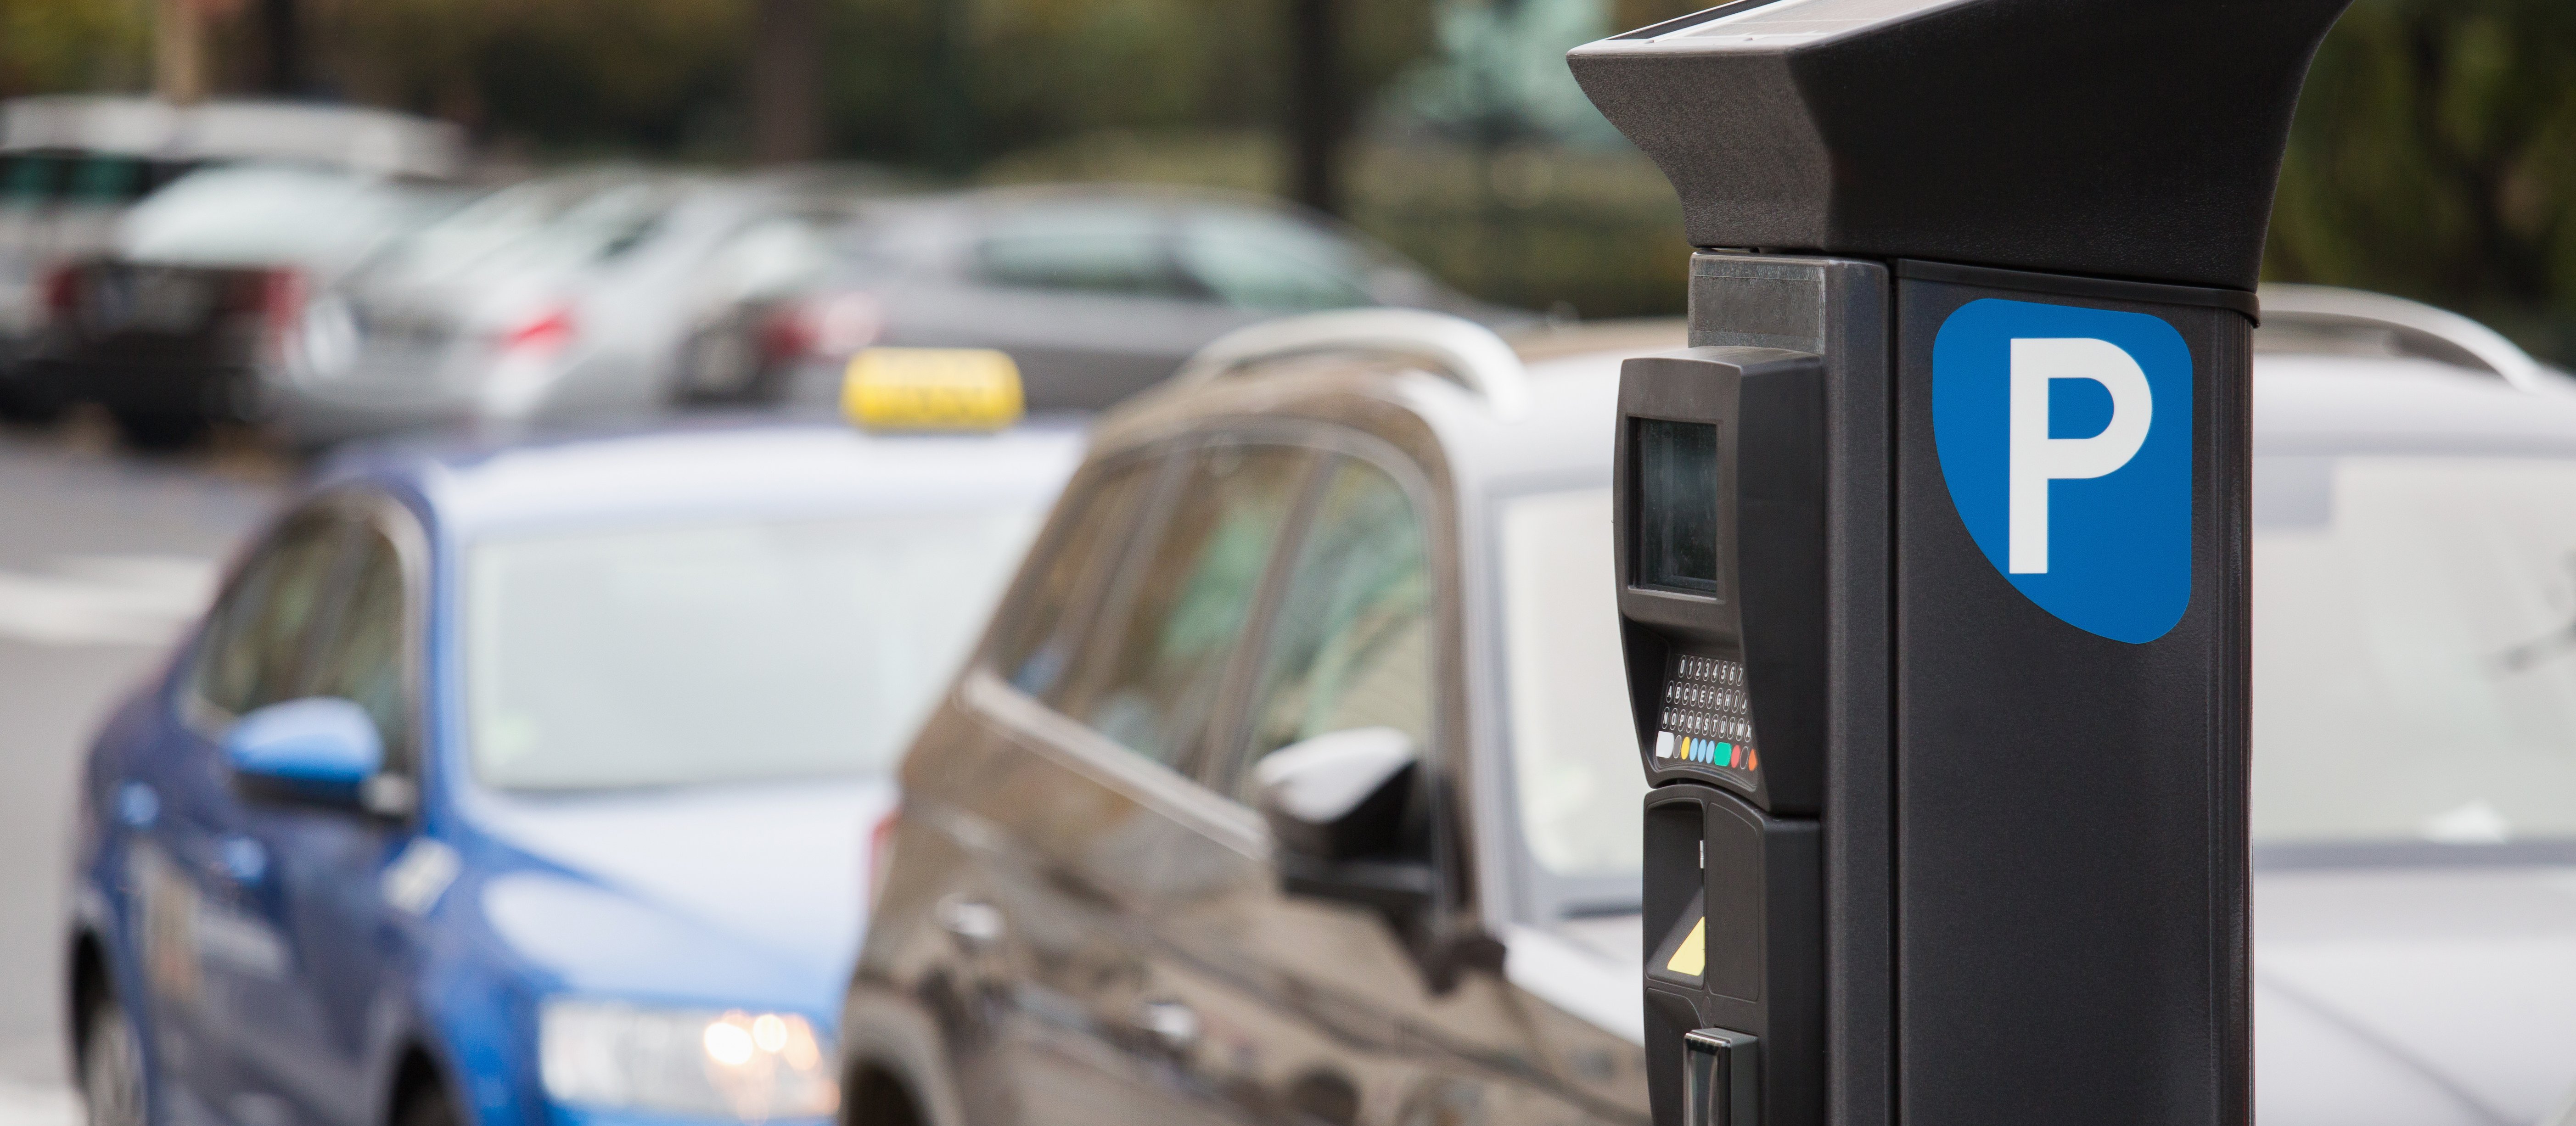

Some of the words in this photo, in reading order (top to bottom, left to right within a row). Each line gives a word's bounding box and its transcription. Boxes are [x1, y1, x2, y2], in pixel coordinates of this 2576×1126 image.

[2009, 338, 2152, 574] P
[1680, 659, 1685, 674] 0
[1689, 661, 1693, 675] 1
[1695, 661, 1701, 676] 2
[1704, 663, 1709, 677] 3
[1712, 664, 1718, 678] 4
[1721, 665, 1726, 679] 5
[1730, 667, 1734, 681] 6
[1738, 667, 1744, 682] 7
[1667, 685, 1672, 697] A
[1675, 687, 1680, 699] B
[1684, 688, 1689, 700] C
[1692, 689, 1697, 701] D
[1700, 690, 1705, 703] E
[1708, 691, 1713, 704] F
[1716, 693, 1722, 705] G
[1724, 694, 1730, 706] H
[1734, 695, 1738, 707] I
[1742, 699, 1747, 709] J
[1663, 712, 1668, 724] N
[1672, 713, 1677, 725] O
[1679, 714, 1684, 726] P
[1688, 716, 1692, 728] Q
[1695, 717, 1701, 729] R
[1704, 718, 1709, 730] S
[1713, 719, 1717, 732] T
[1720, 721, 1725, 733] U
[1729, 722, 1734, 734] V
[1737, 723, 1744, 736] W
[1745, 725, 1751, 737] X
